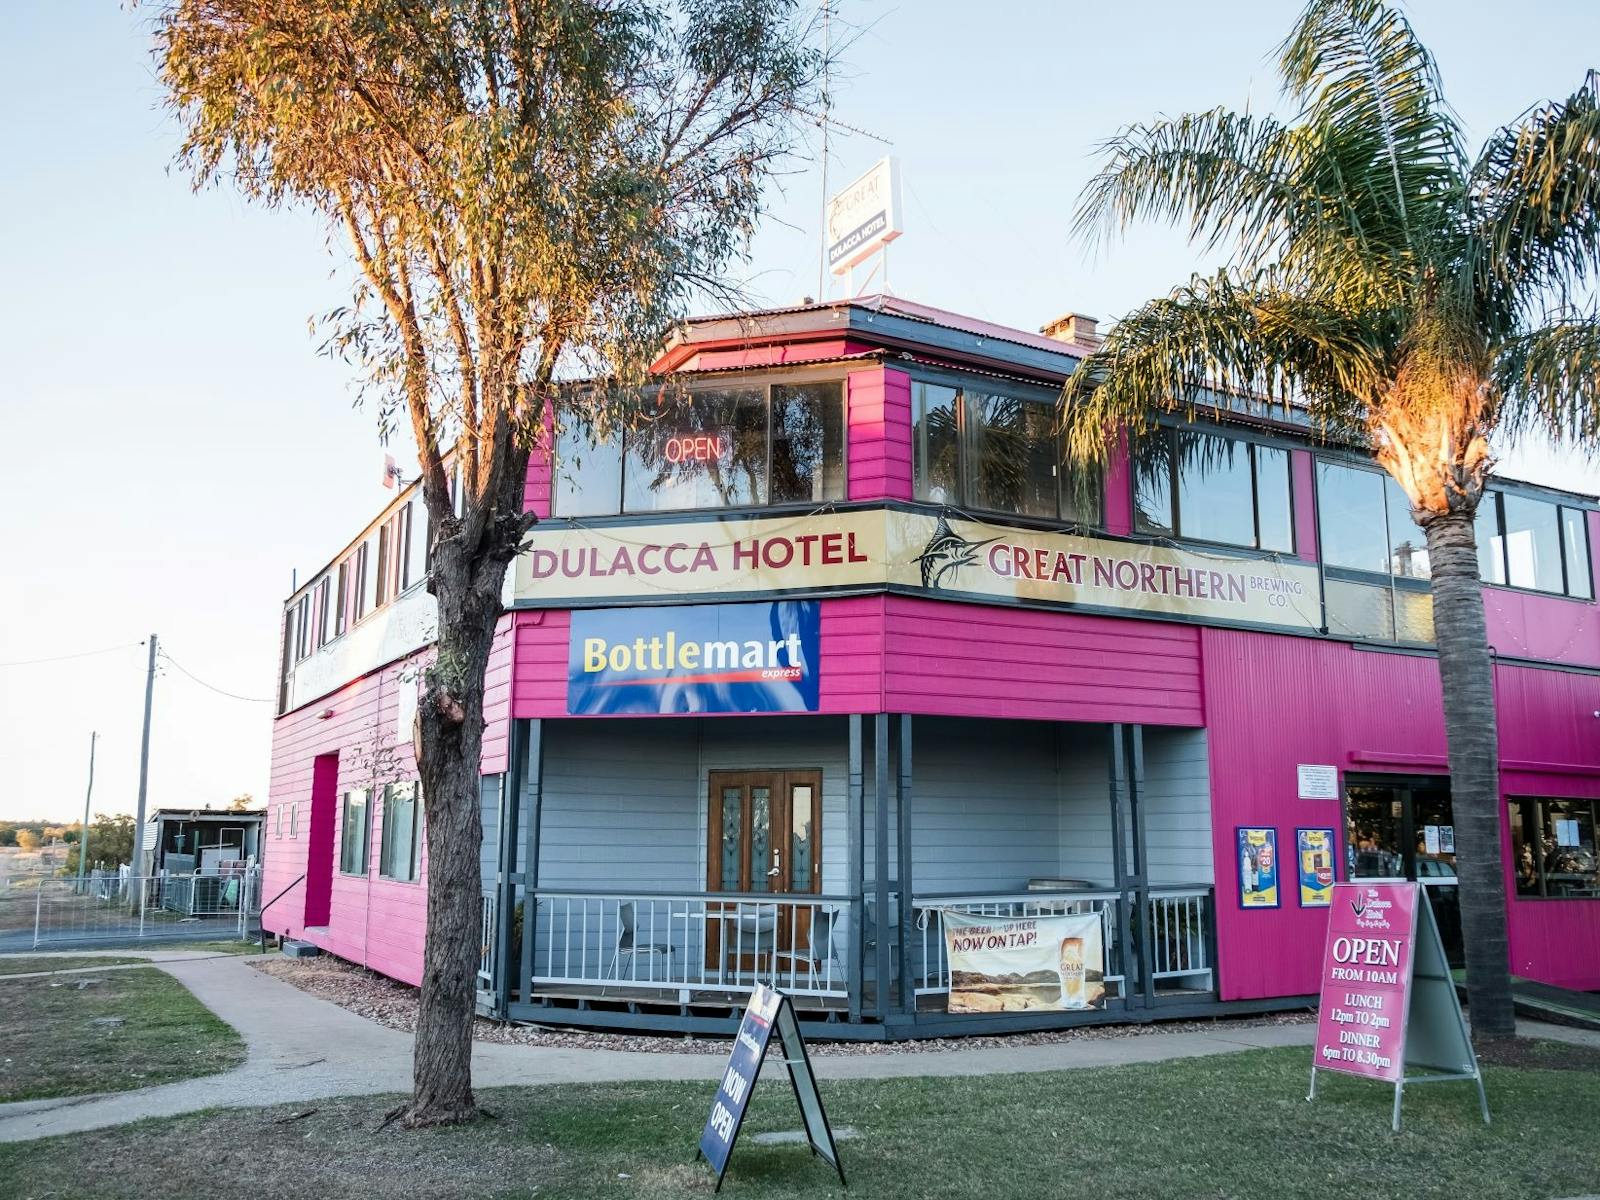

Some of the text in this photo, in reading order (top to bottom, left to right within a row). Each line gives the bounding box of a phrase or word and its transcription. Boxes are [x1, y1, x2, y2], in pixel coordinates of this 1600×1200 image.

[830, 216, 886, 261] DULACCA HOTEL
[665, 437, 720, 462] OPEN
[531, 531, 868, 579] DULACCA HOTEL
[987, 543, 1302, 603] GREAT NORTHERN BREWING
[1268, 594, 1288, 608] CO.
[583, 631, 802, 673] Bottlemart
[761, 667, 801, 680] express
[1003, 924, 1014, 933] UP
[1016, 921, 1037, 932] HERE
[953, 931, 1037, 952] NOW ON TAP!
[1332, 937, 1402, 966] OPEN
[1331, 967, 1398, 985] FROM 10AM
[1344, 993, 1383, 1009] LUNCH
[1331, 1008, 1390, 1030] 12pm TO 2pm
[1339, 1030, 1381, 1049] DINNER
[1322, 1044, 1391, 1070] 6pm TO 8.30pm
[722, 1066, 747, 1105] NOW
[710, 1101, 736, 1143] OPEN
